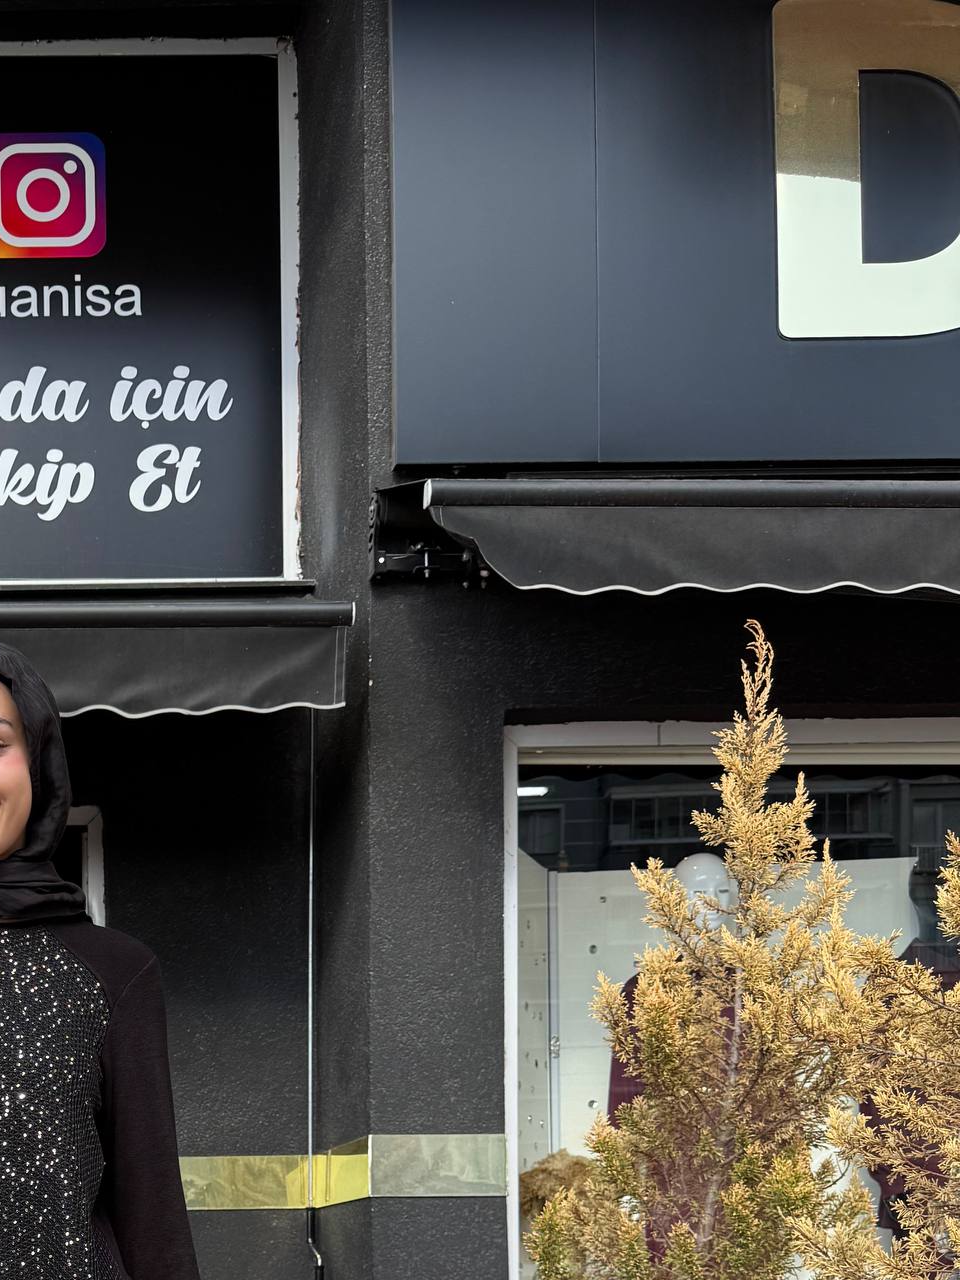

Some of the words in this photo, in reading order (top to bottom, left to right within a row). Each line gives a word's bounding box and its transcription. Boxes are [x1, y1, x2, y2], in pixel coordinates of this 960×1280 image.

[772, 0, 960, 338] D
[109, 365, 233, 429] için
[129, 443, 202, 512] Et
